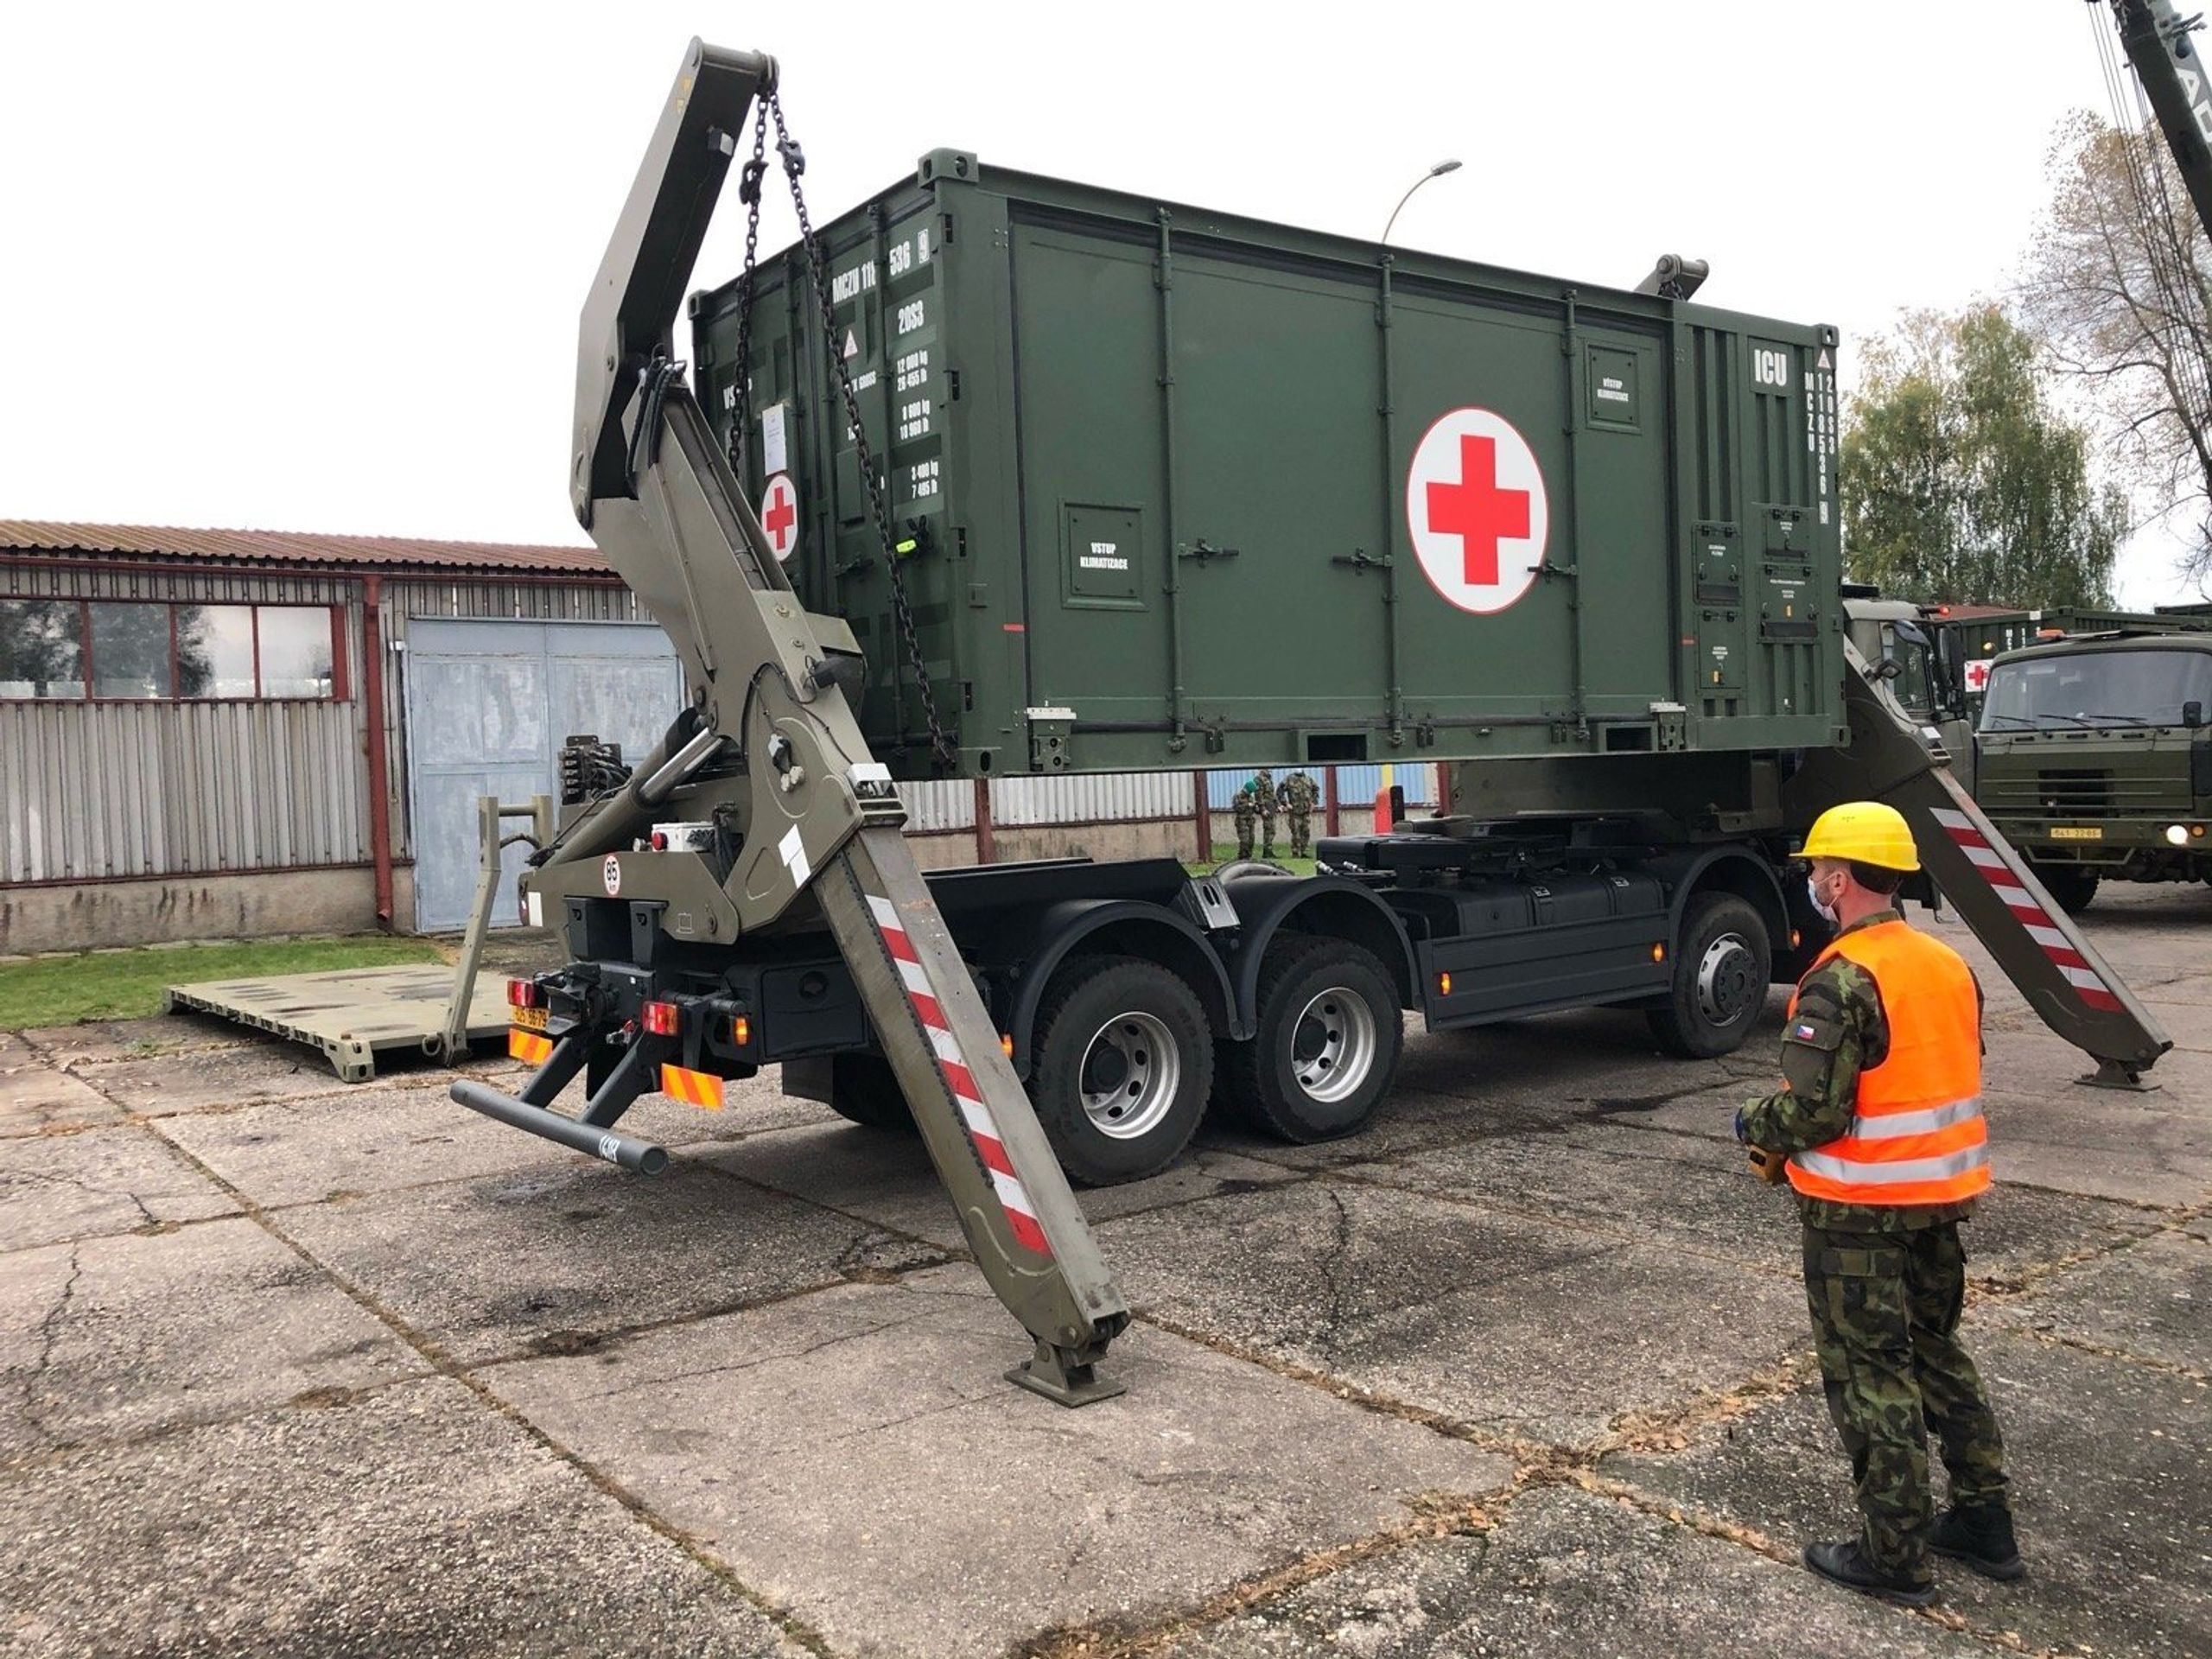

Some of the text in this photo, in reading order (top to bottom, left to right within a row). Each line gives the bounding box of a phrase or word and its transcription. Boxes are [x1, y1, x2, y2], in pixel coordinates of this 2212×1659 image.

[832, 266, 860, 304] MCZU
[889, 240, 911, 276] 536
[1754, 348, 1788, 387] ICU
[1090, 542, 1116, 554] VSTUP
[1079, 556, 1128, 570] KLIMATIZACE
[607, 861, 618, 881] 85
